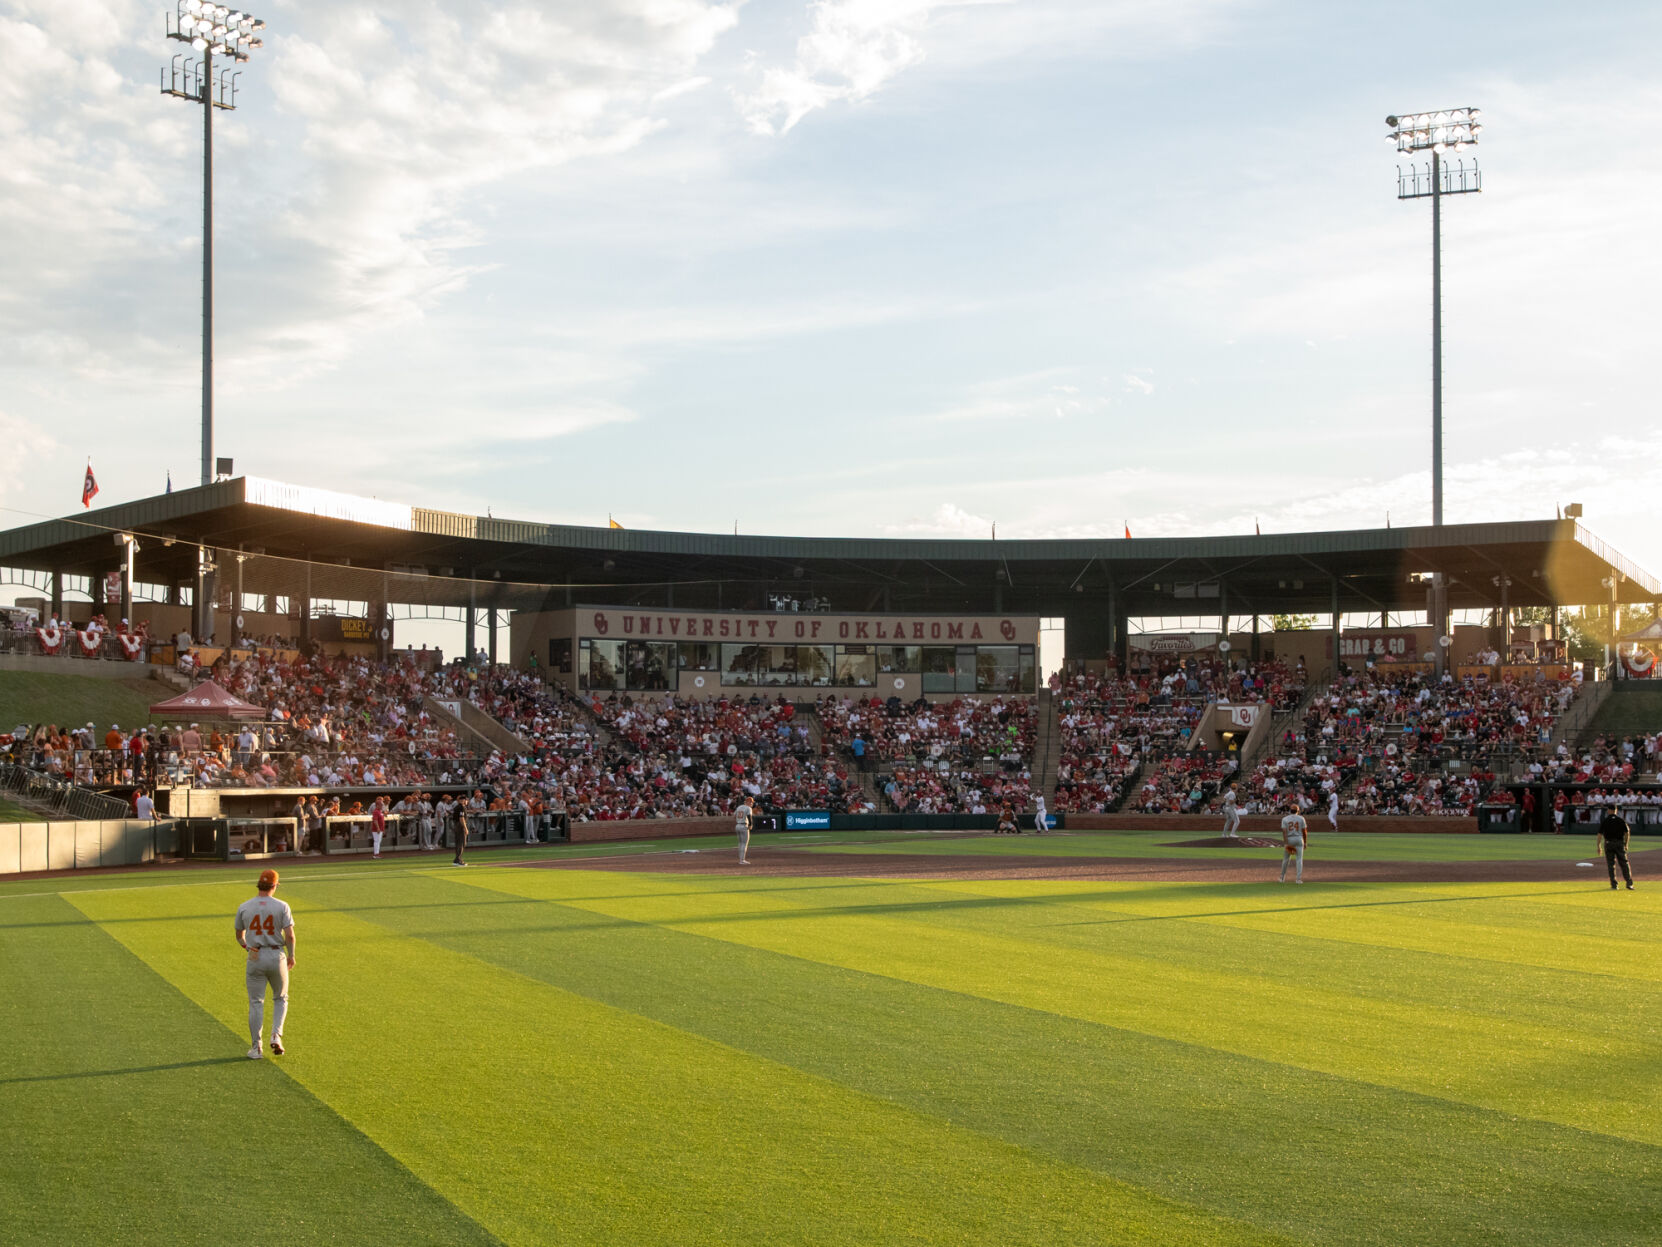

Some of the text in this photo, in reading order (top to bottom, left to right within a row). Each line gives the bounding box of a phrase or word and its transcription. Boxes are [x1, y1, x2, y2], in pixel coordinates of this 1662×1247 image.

[594, 613, 1016, 641] OU UNIVERSITY OF OKLAHOMA OU
[1339, 638, 1405, 655] GRAB & GO
[1240, 709, 1251, 723] OU
[795, 817, 828, 825] Higginbotham
[1287, 821, 1300, 832] 24
[249, 914, 275, 936] 44
